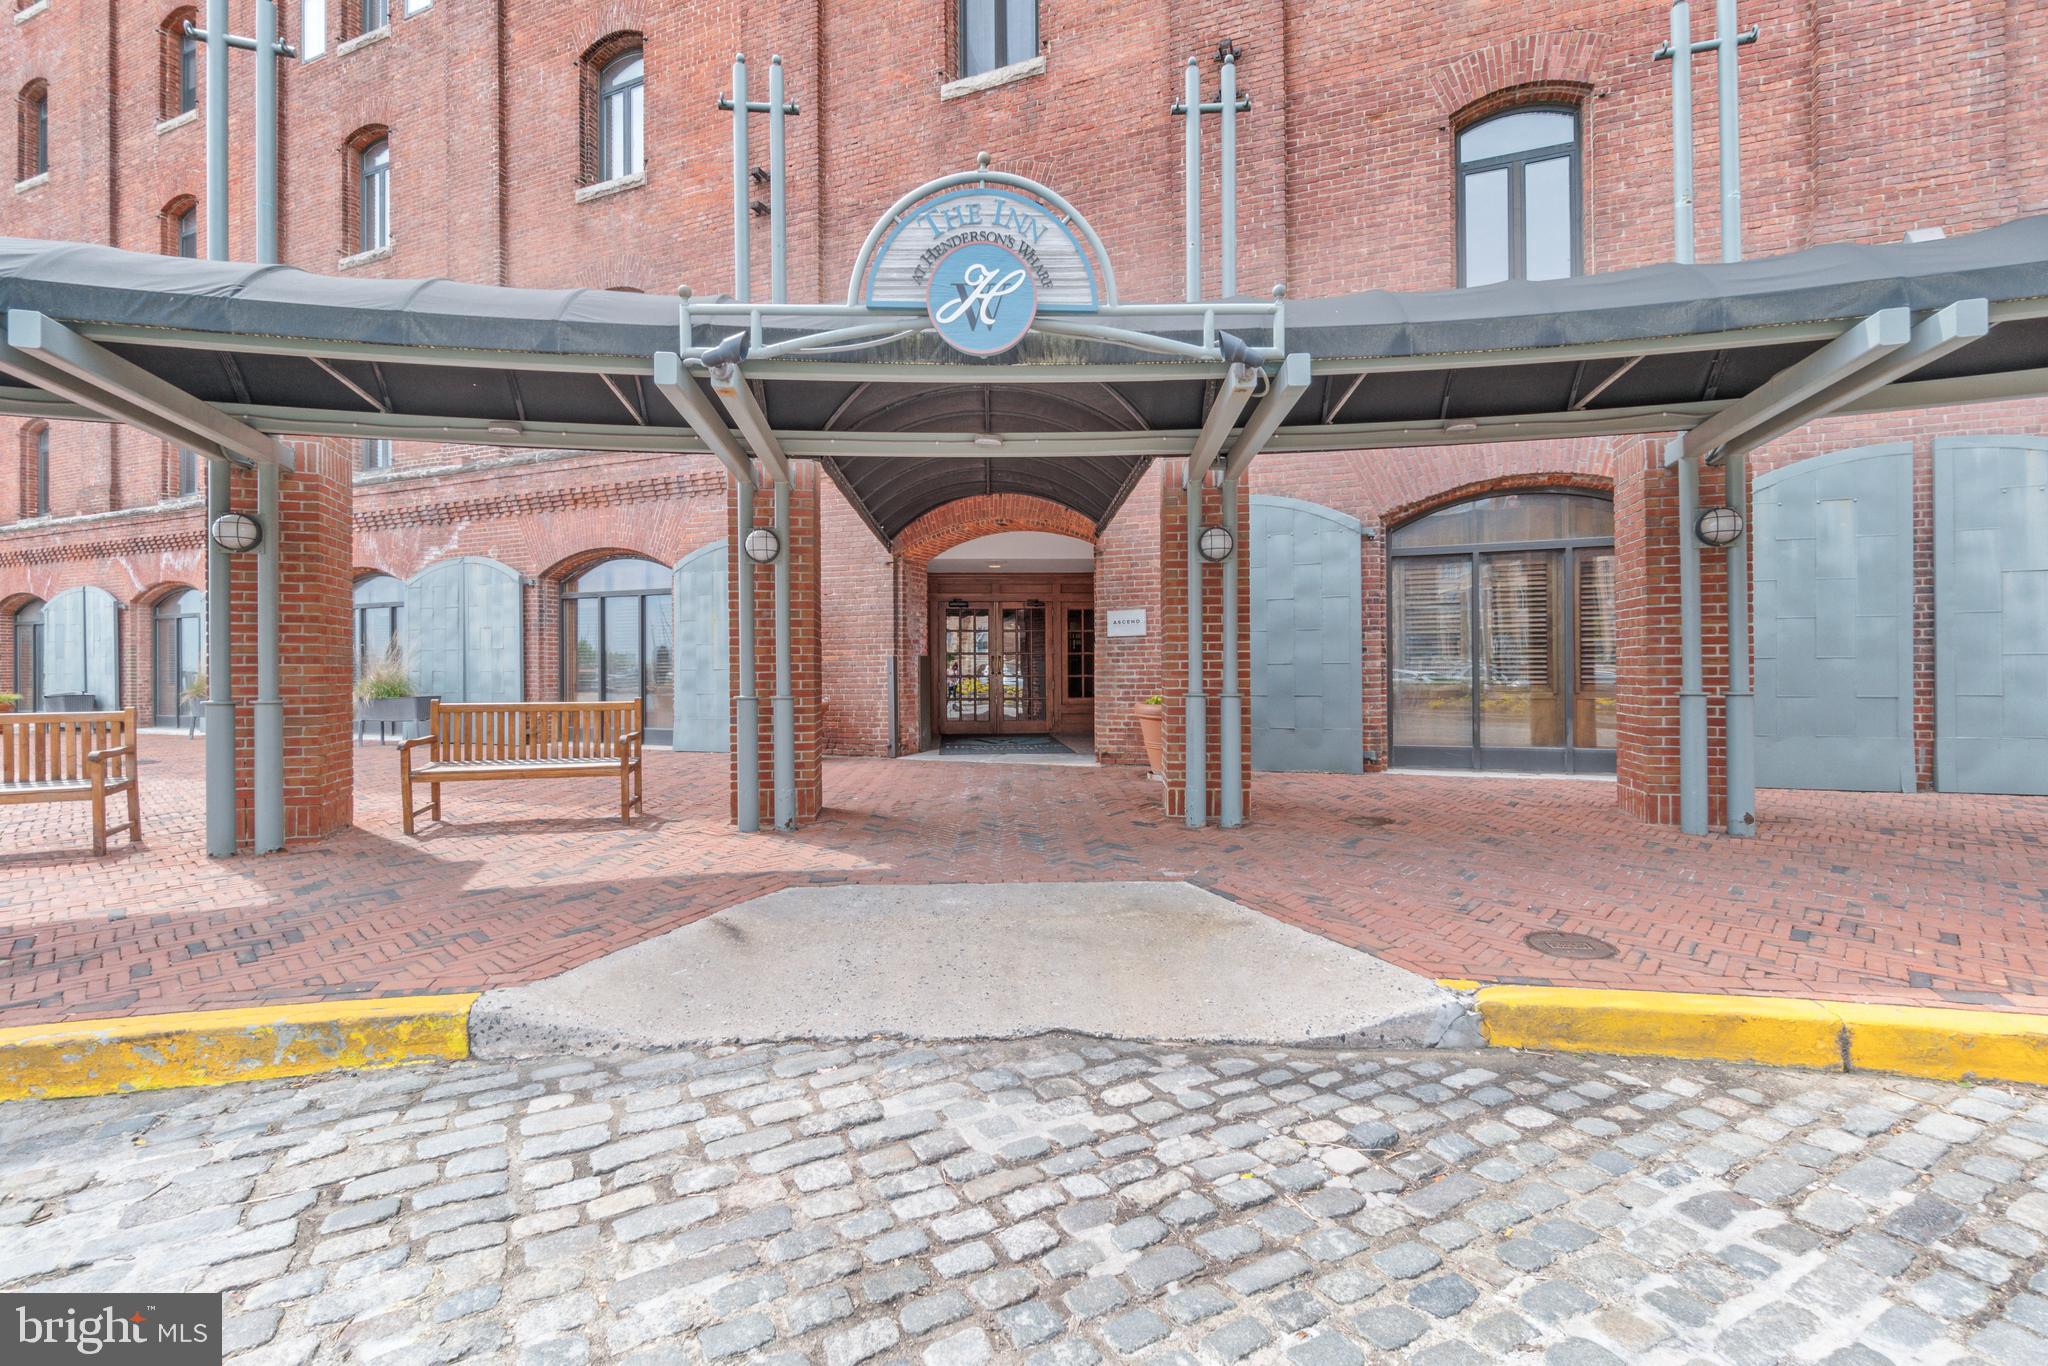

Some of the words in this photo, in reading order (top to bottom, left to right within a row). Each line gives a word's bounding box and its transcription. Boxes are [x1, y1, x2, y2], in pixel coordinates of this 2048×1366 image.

[916, 204, 983, 239] THE
[992, 199, 1048, 242] INN
[912, 263, 926, 286] AT
[920, 231, 1016, 267] HENDERSON'S
[1018, 240, 1053, 289] WHARF
